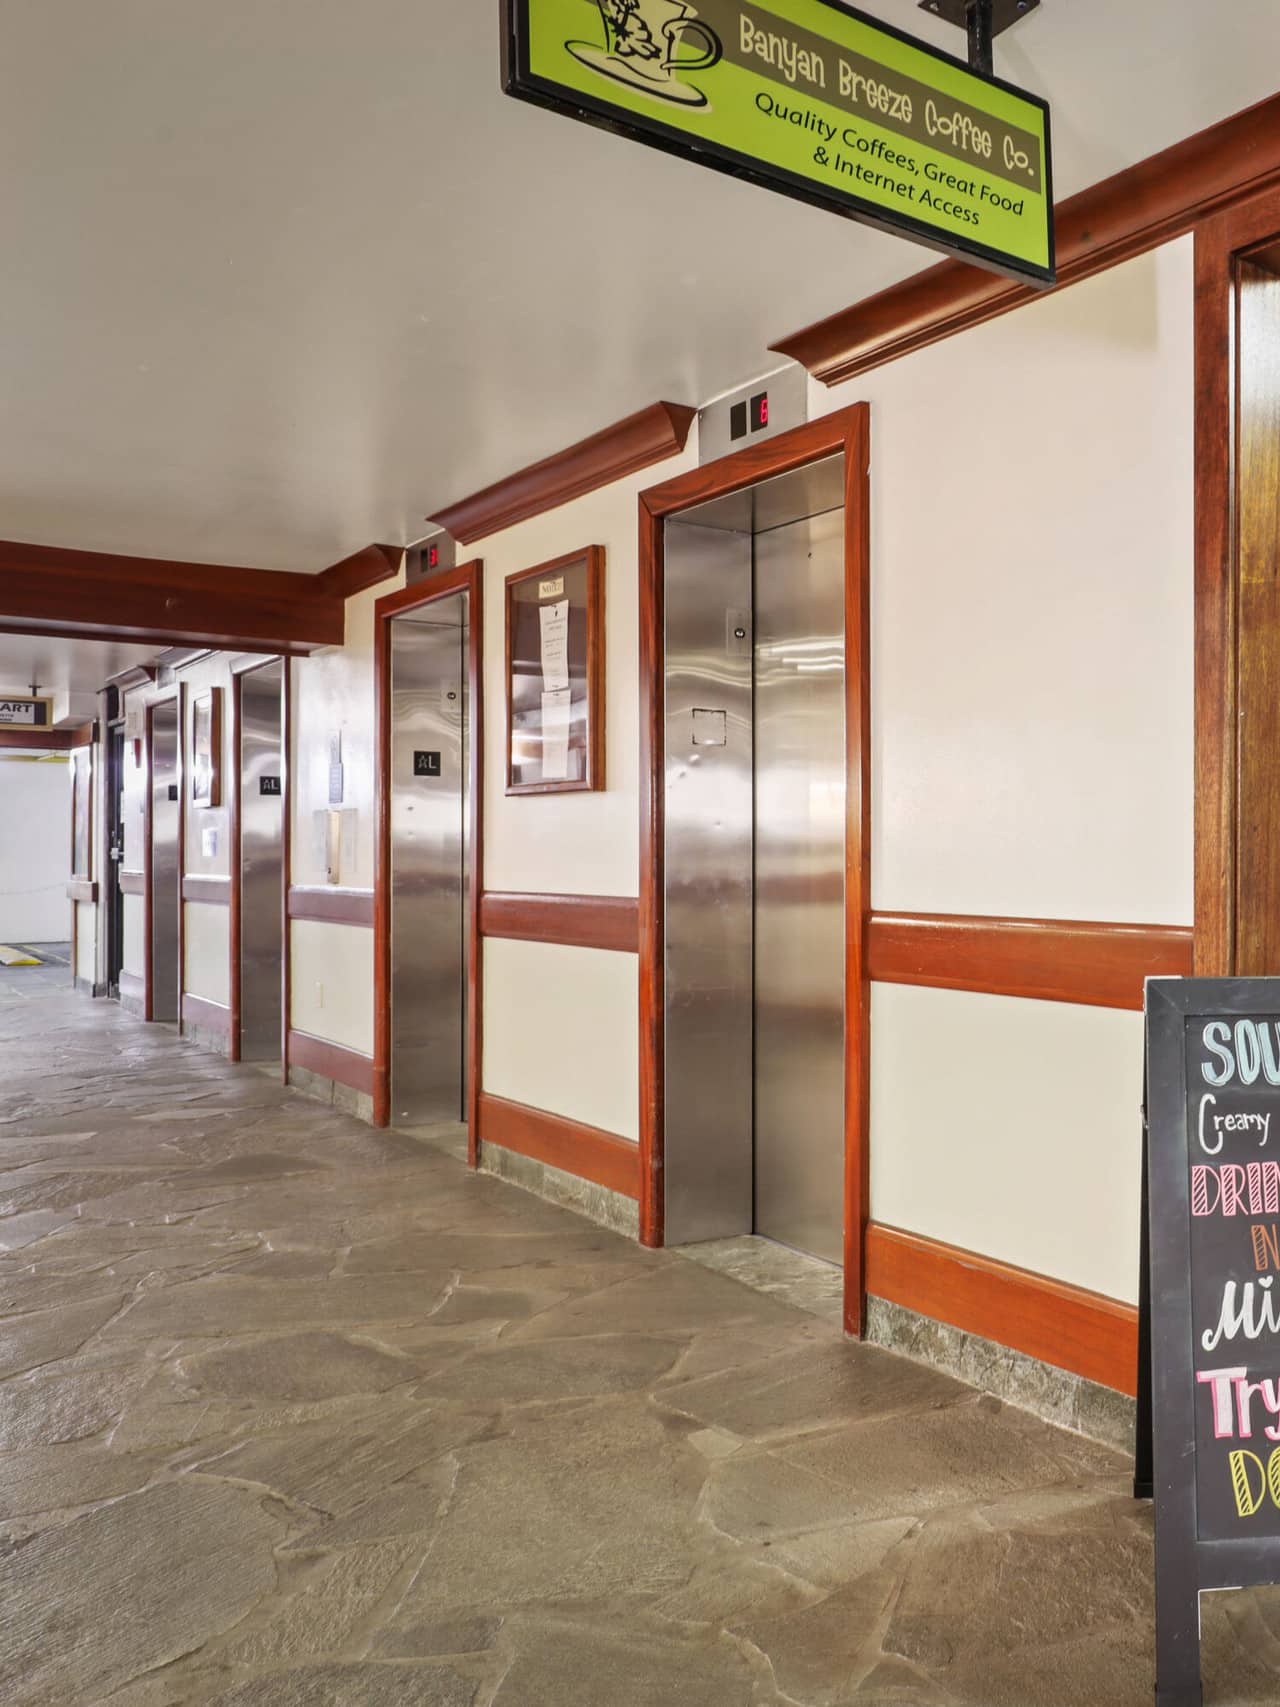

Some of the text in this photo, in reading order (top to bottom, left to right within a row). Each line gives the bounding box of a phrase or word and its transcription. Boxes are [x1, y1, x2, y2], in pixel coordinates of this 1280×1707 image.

[739, 13, 1035, 177] Banyan Breeze Coffee Co.
[755, 92, 1024, 217] Quality Coffees, Great Food
[813, 145, 980, 226] & Internet Access
[1199, 1093, 1271, 1155] Creamy
